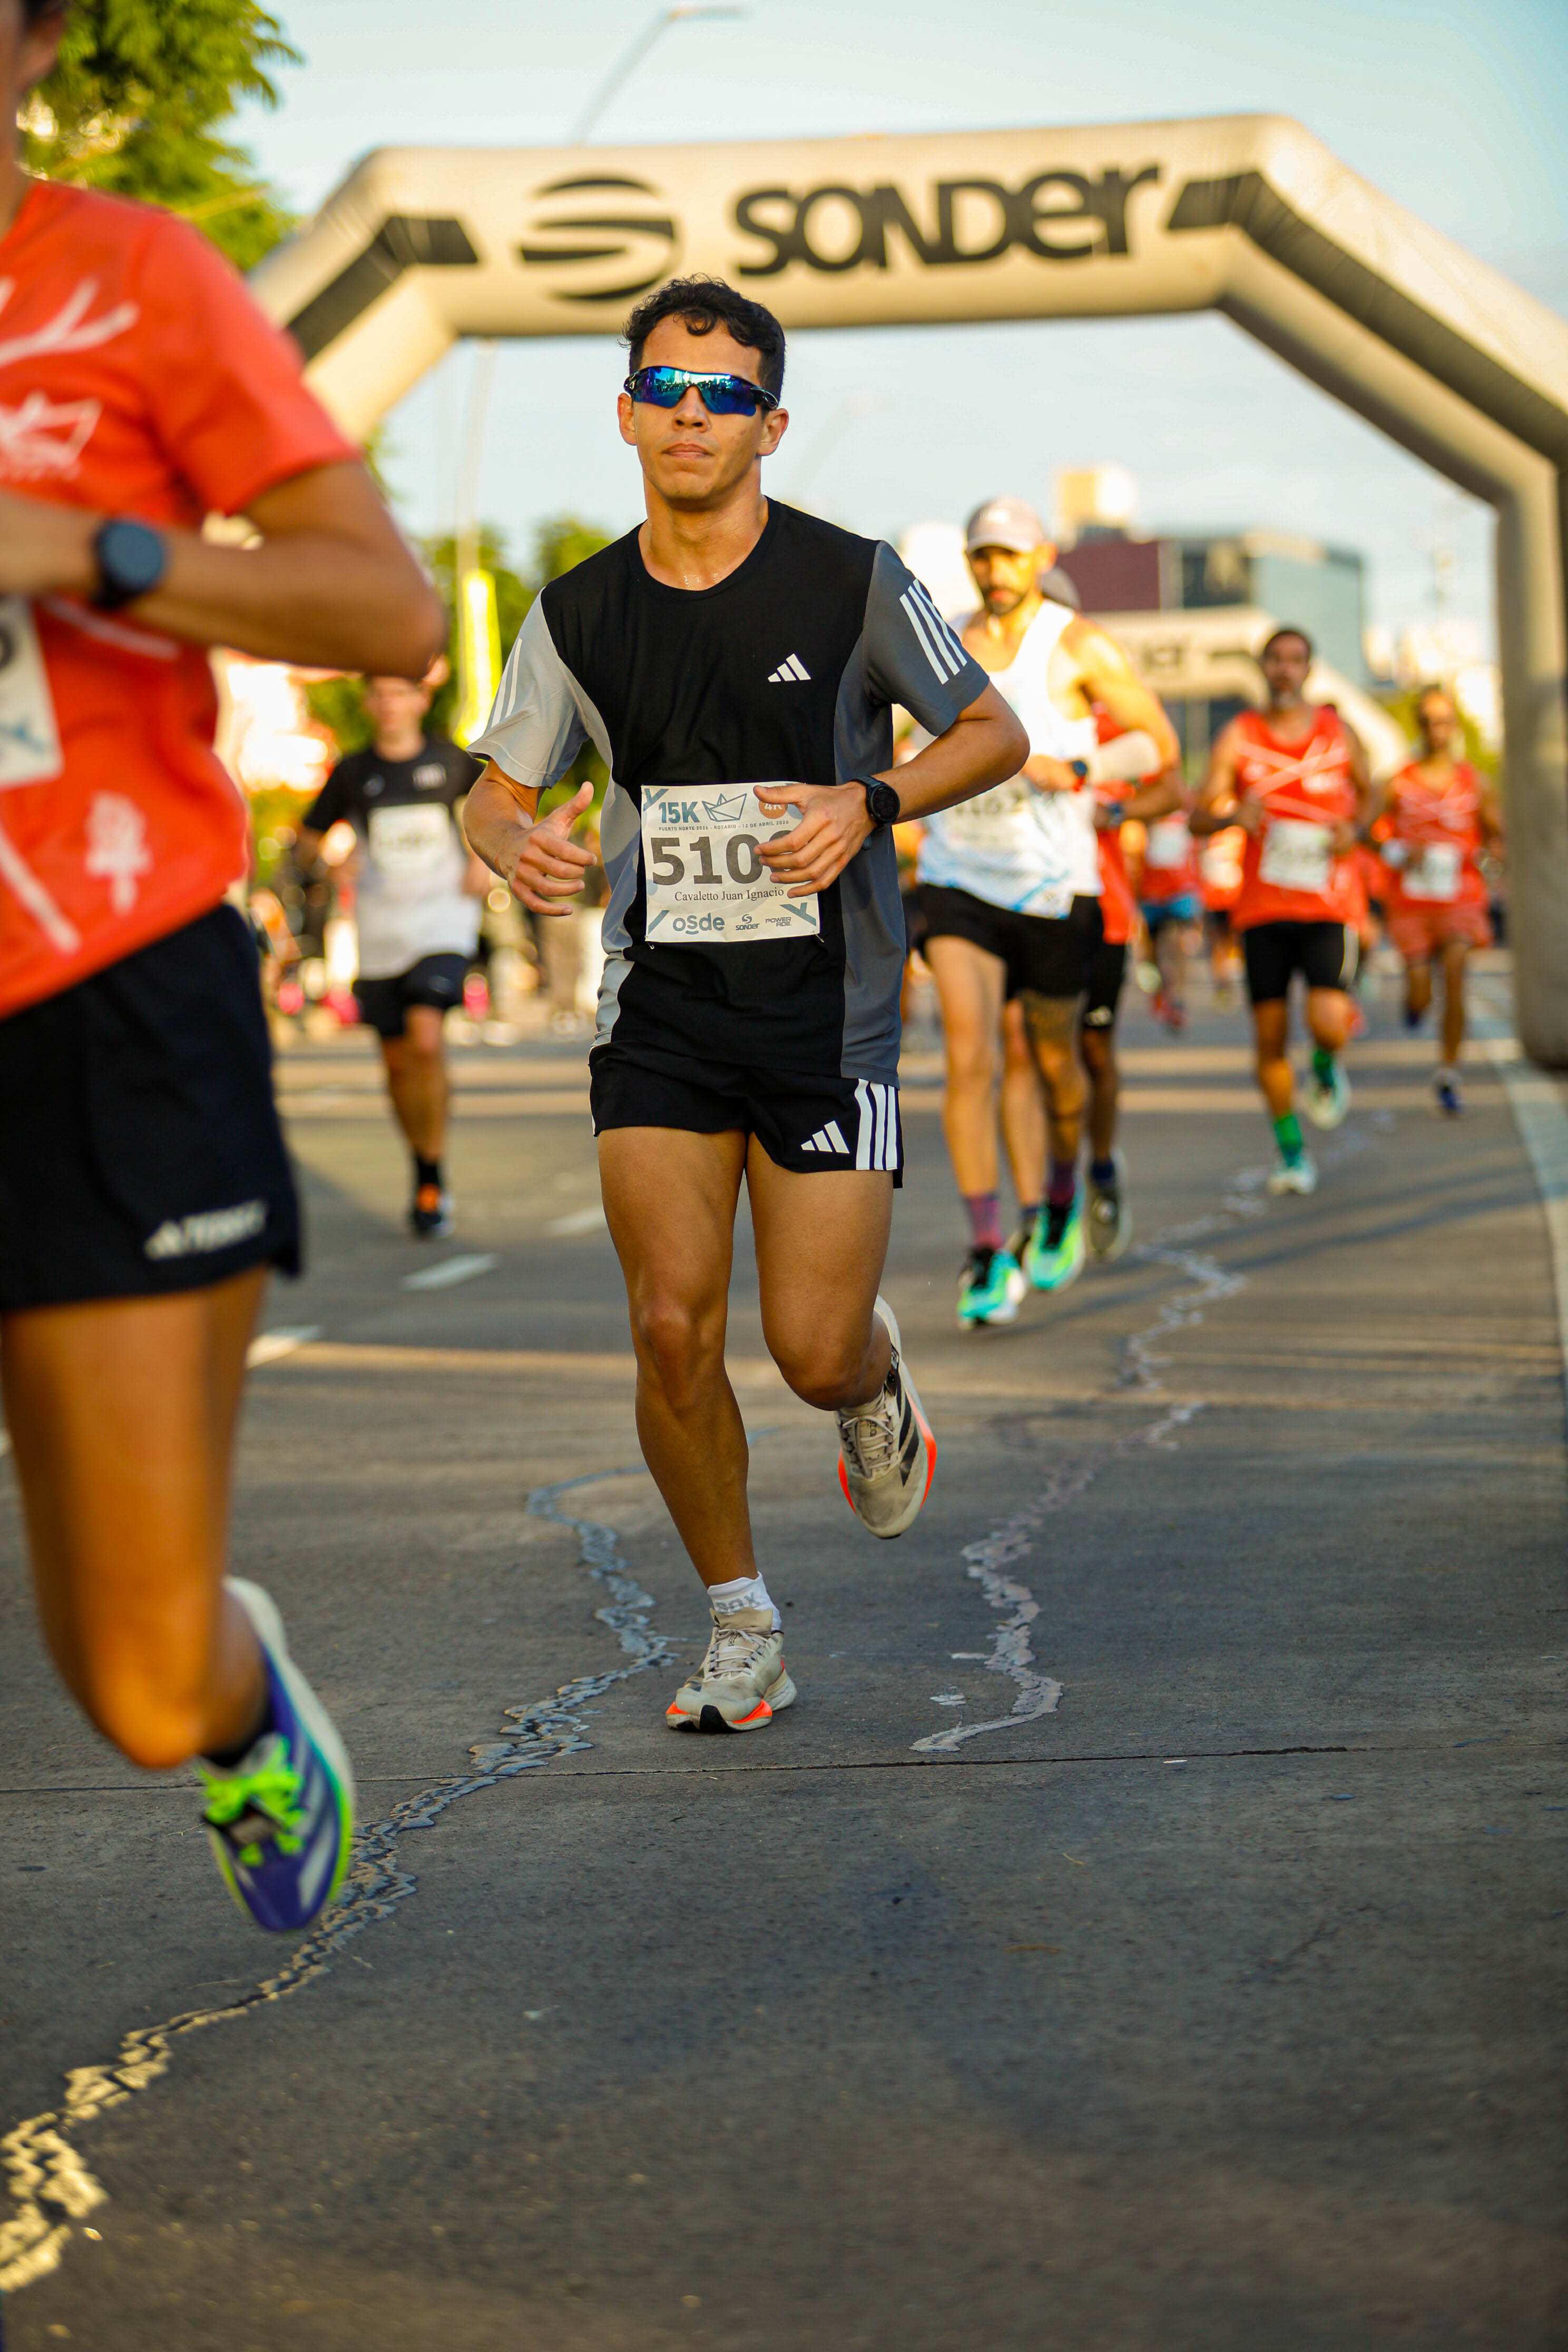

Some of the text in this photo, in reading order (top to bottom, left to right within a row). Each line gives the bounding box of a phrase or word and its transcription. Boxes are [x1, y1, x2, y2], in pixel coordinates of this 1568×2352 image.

[658, 801, 700, 824] 15K
[651, 830, 792, 885] 510
[674, 887, 784, 901] Cavaletto Juan Ignacio
[672, 913, 725, 932] osde
